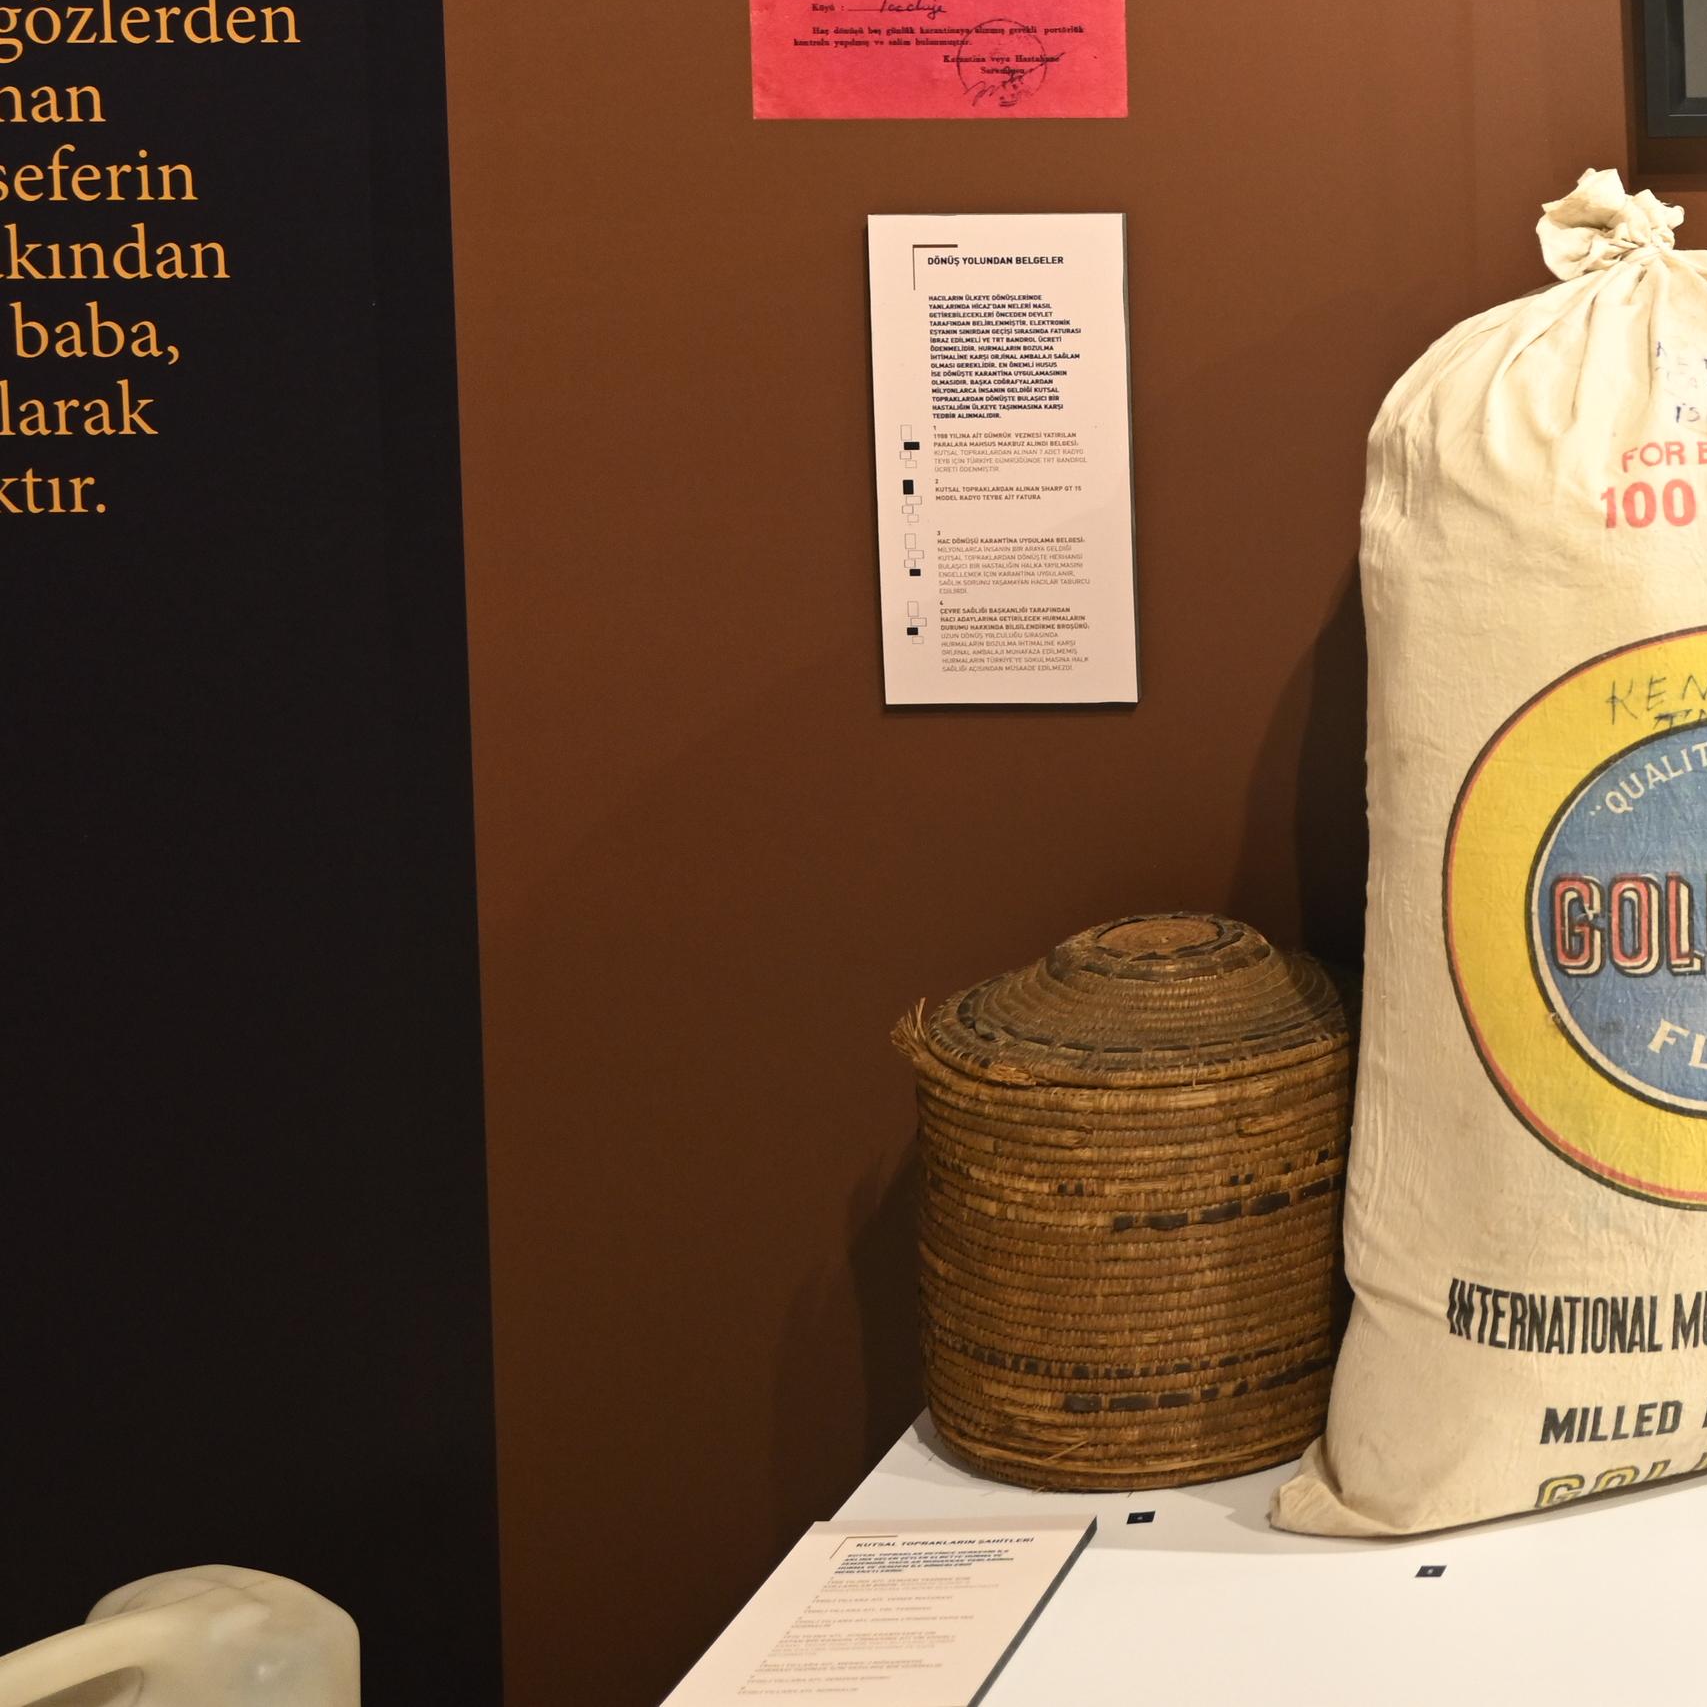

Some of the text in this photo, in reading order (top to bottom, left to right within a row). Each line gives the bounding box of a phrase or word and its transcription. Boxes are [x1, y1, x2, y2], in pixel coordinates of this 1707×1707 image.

[0, 222, 230, 279] kından
[927, 255, 1064, 267] DÖNÜŞ YOLUNDAN BELGELER
[10, 301, 179, 365] baba,
[0, 379, 159, 436] larak
[1621, 440, 1685, 473] FOR
[1600, 477, 1697, 529] 100
[1446, 1276, 1664, 1355] INTERNATIONAL
[1540, 1401, 1682, 1446] MILLED
